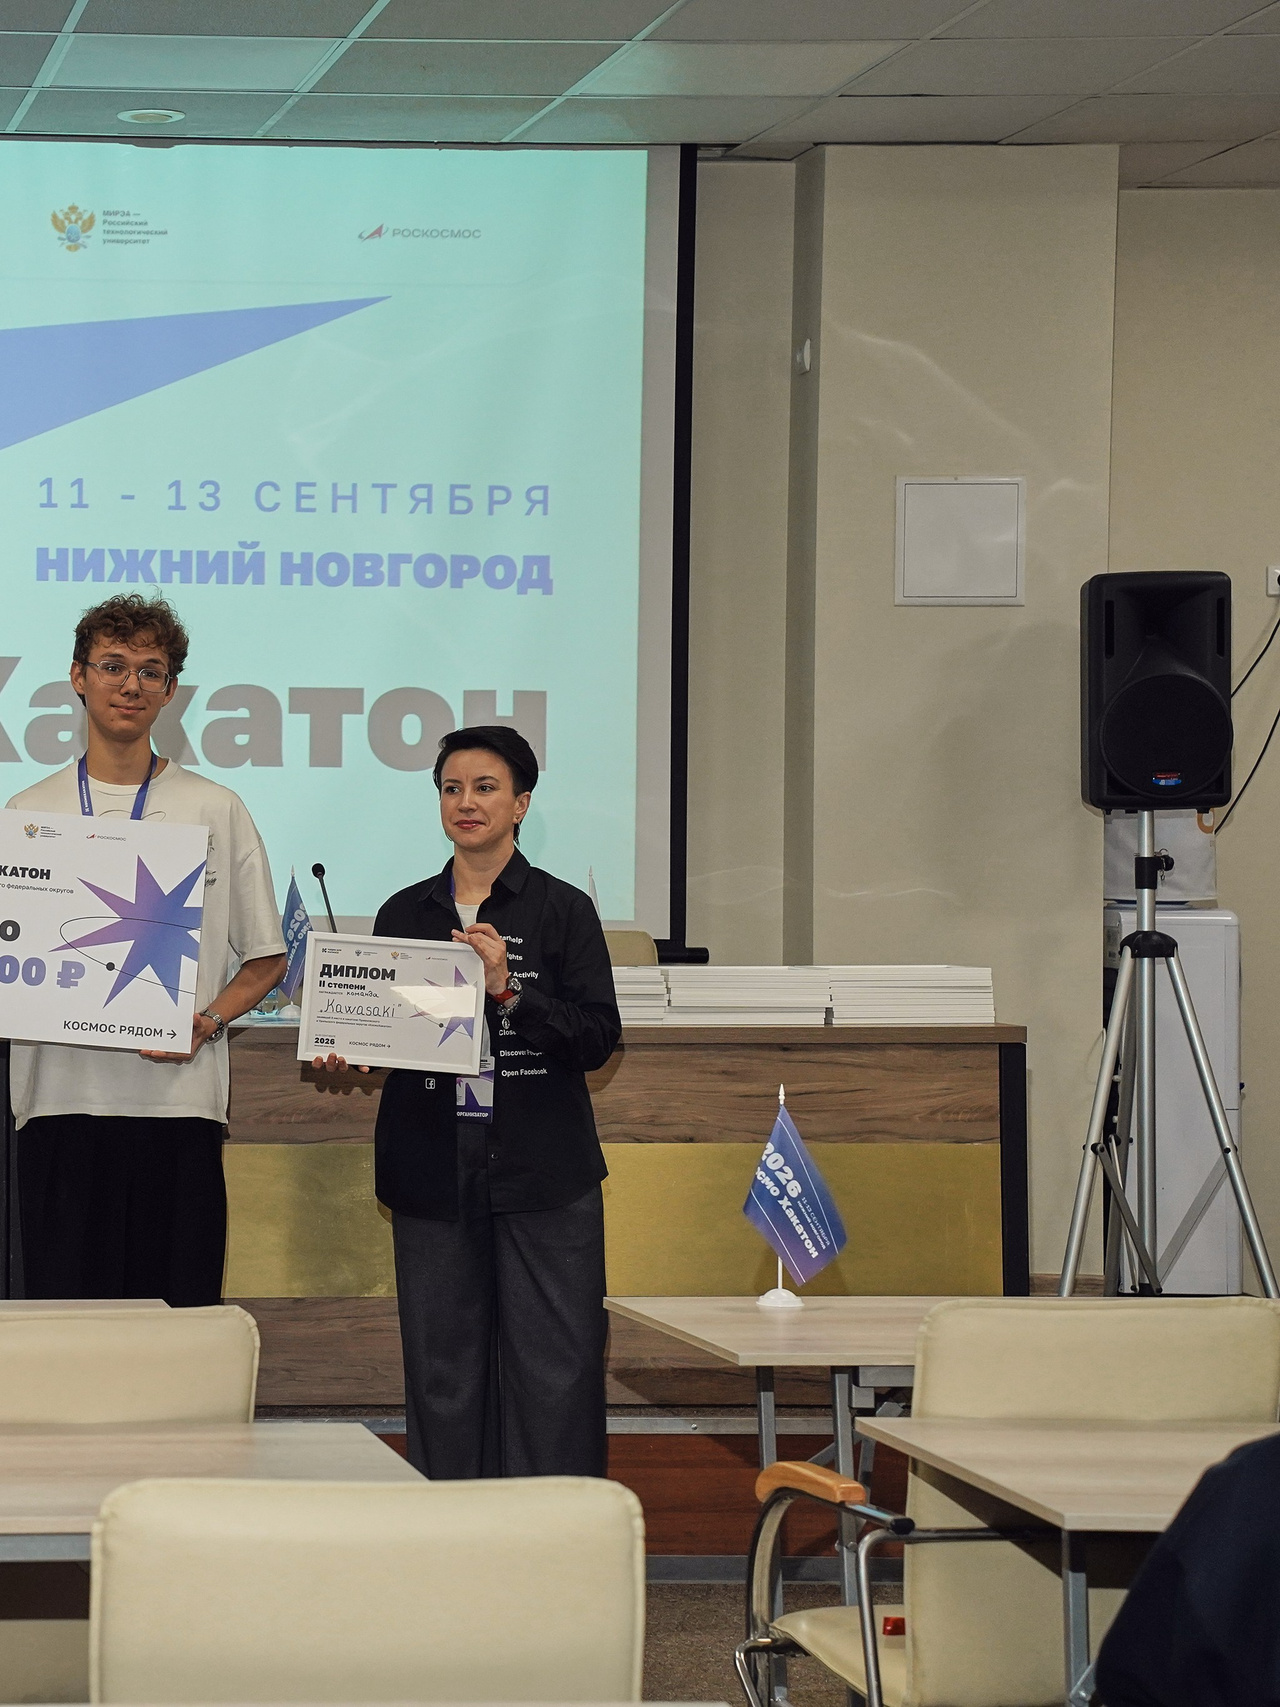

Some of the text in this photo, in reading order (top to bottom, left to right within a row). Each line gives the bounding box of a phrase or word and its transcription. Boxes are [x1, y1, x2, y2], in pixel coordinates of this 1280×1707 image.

[392, 228, 482, 238] РОСКОСМОС
[38, 477, 89, 510] 11
[167, 479, 222, 512] 13
[254, 481, 550, 516] СЕНТЯБРЯ
[35, 541, 554, 596] НИЖНИЙ НОВГОРОД
[6, 883, 48, 893] федеральных
[319, 963, 396, 981] ДИПЛОМ
[513, 971, 539, 979] Activity
[327, 981, 366, 991] степени
[346, 990, 379, 998] команда
[63, 1020, 163, 1038] КОСМОС РЯДОМ
[314, 1037, 335, 1045] 2026
[501, 1067, 548, 1078] Open Facebook
[761, 1142, 802, 1198] 2026
[777, 1195, 819, 1259] Хакатон
[810, 1212, 830, 1246] СЕНТЯБРЯ
